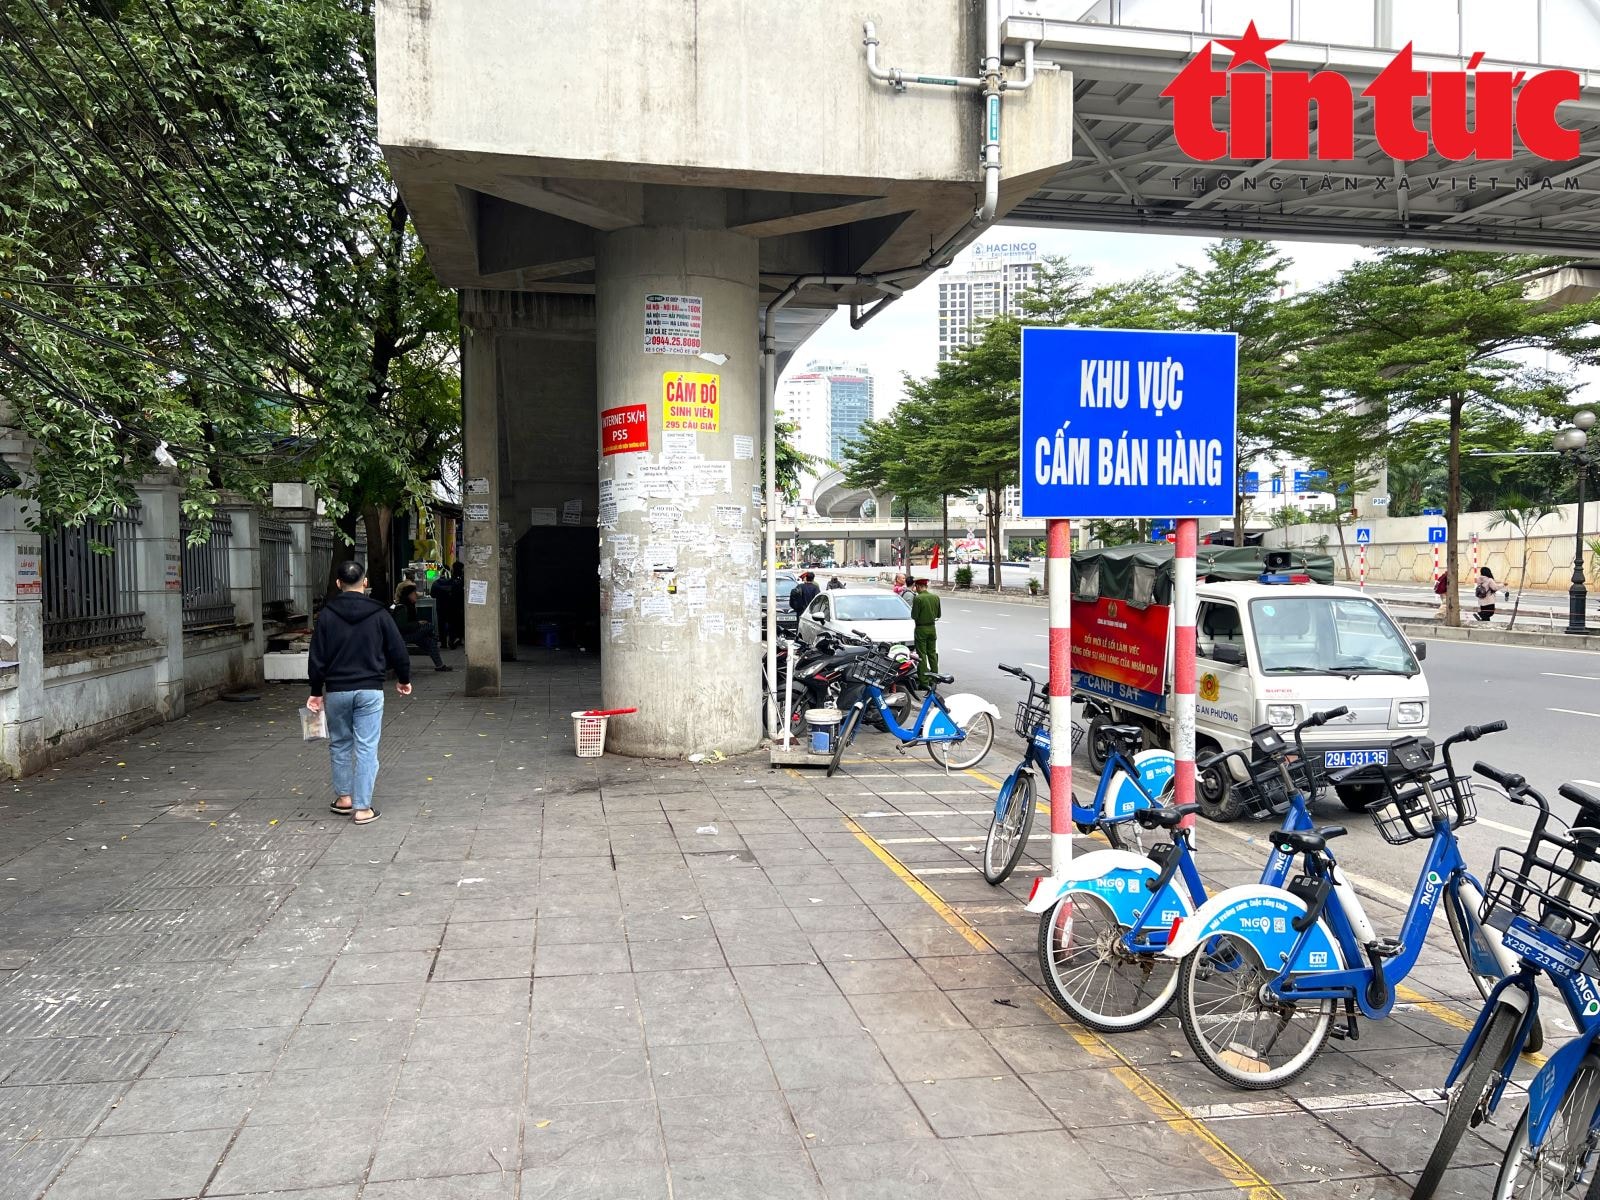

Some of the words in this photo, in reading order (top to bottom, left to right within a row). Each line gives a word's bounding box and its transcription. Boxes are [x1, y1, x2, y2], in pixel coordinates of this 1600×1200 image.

[986, 242, 1037, 252] HACINCO
[1080, 359, 1130, 409] KHU
[1138, 356, 1184, 417] VỰC
[670, 406, 692, 417] SINH
[694, 405, 714, 418] VIÊN
[666, 420, 680, 429] 295
[612, 429, 629, 442] PS5
[1035, 420, 1090, 486] CẤM
[1098, 430, 1148, 486] BÁN
[1157, 430, 1222, 487] HÀNG
[1201, 706, 1210, 716] AN
